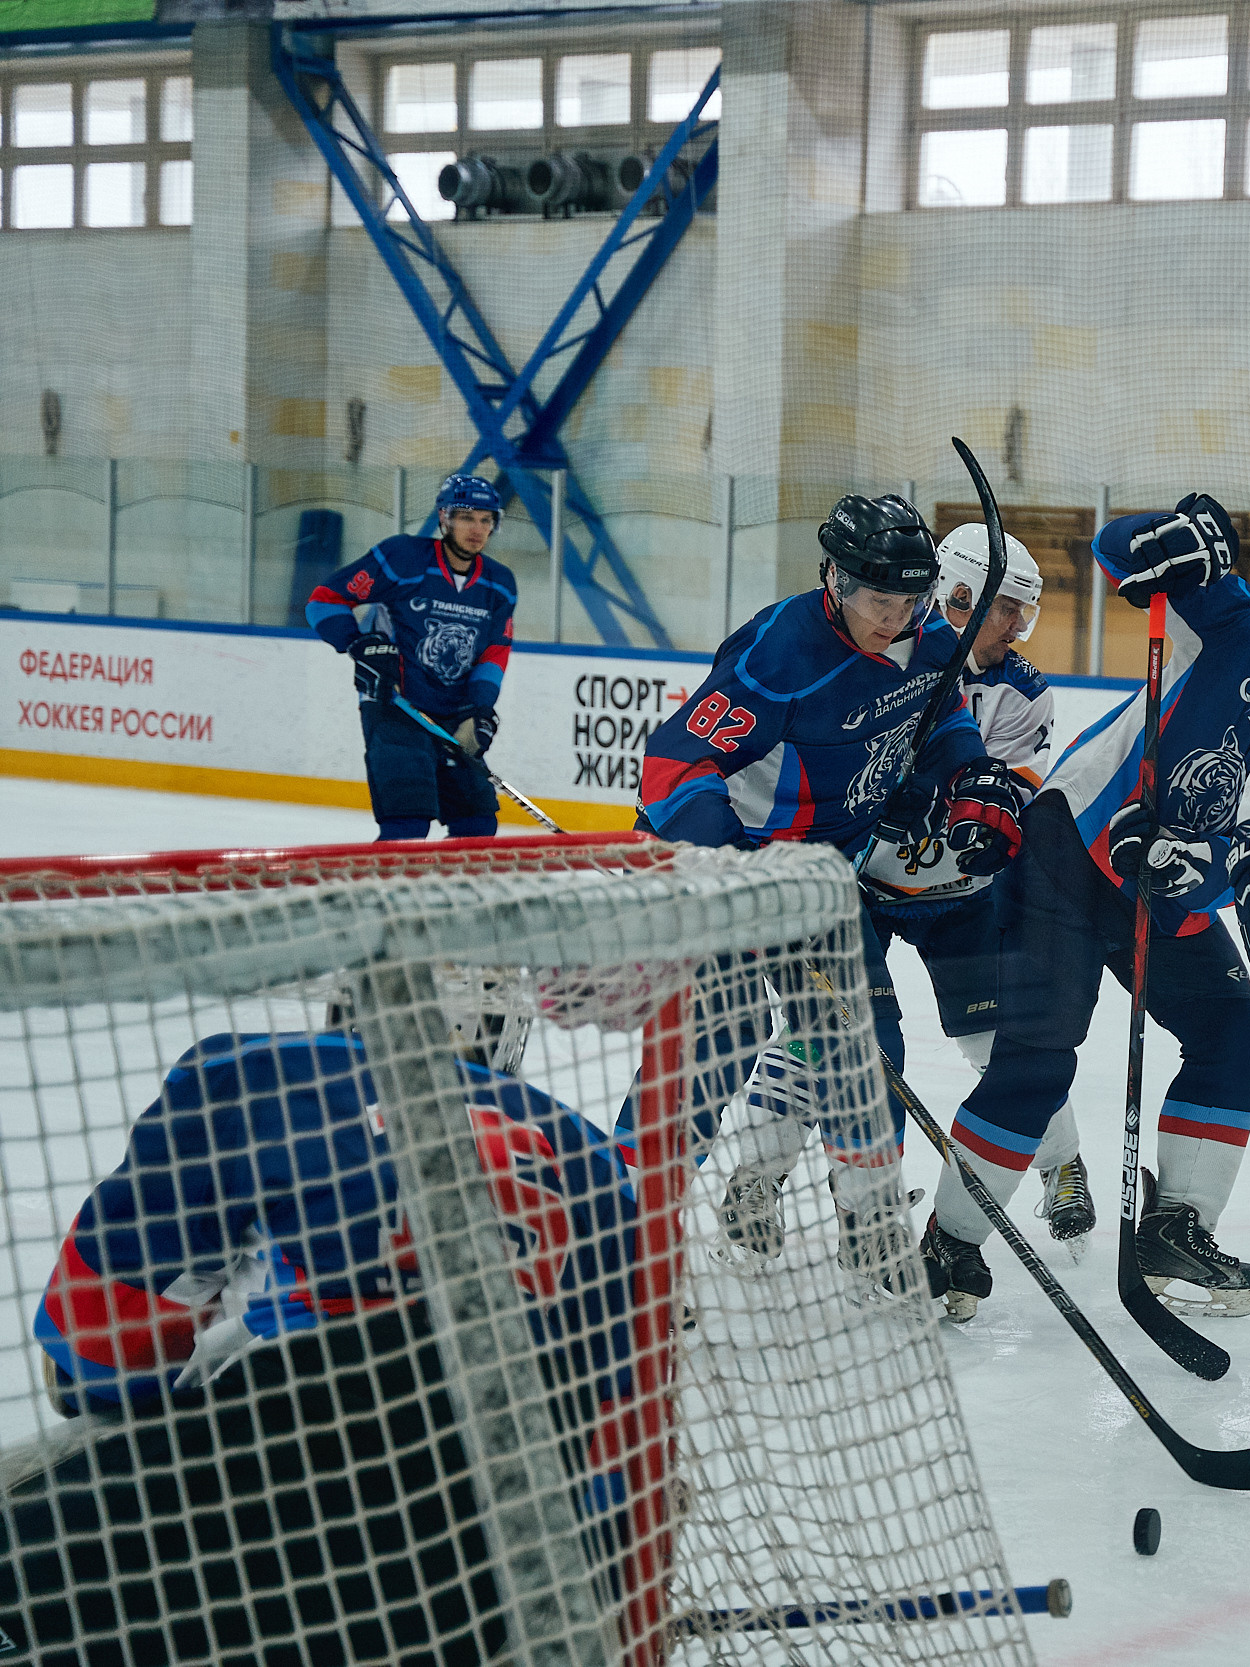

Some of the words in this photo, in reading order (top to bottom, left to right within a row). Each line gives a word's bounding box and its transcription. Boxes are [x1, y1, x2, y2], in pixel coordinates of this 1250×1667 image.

[835, 509, 857, 532] CCM
[901, 568, 930, 578] CCM
[19, 648, 154, 688] ФЕДЕРАЦИЯ
[576, 675, 667, 712] СПОРТ
[874, 682, 925, 719] ДАЛЬНИЙ
[18, 700, 104, 733] ХОККЕЯ
[110, 707, 213, 741] РОССИИ
[686, 690, 757, 753] 82
[958, 774, 1012, 791] BAU
